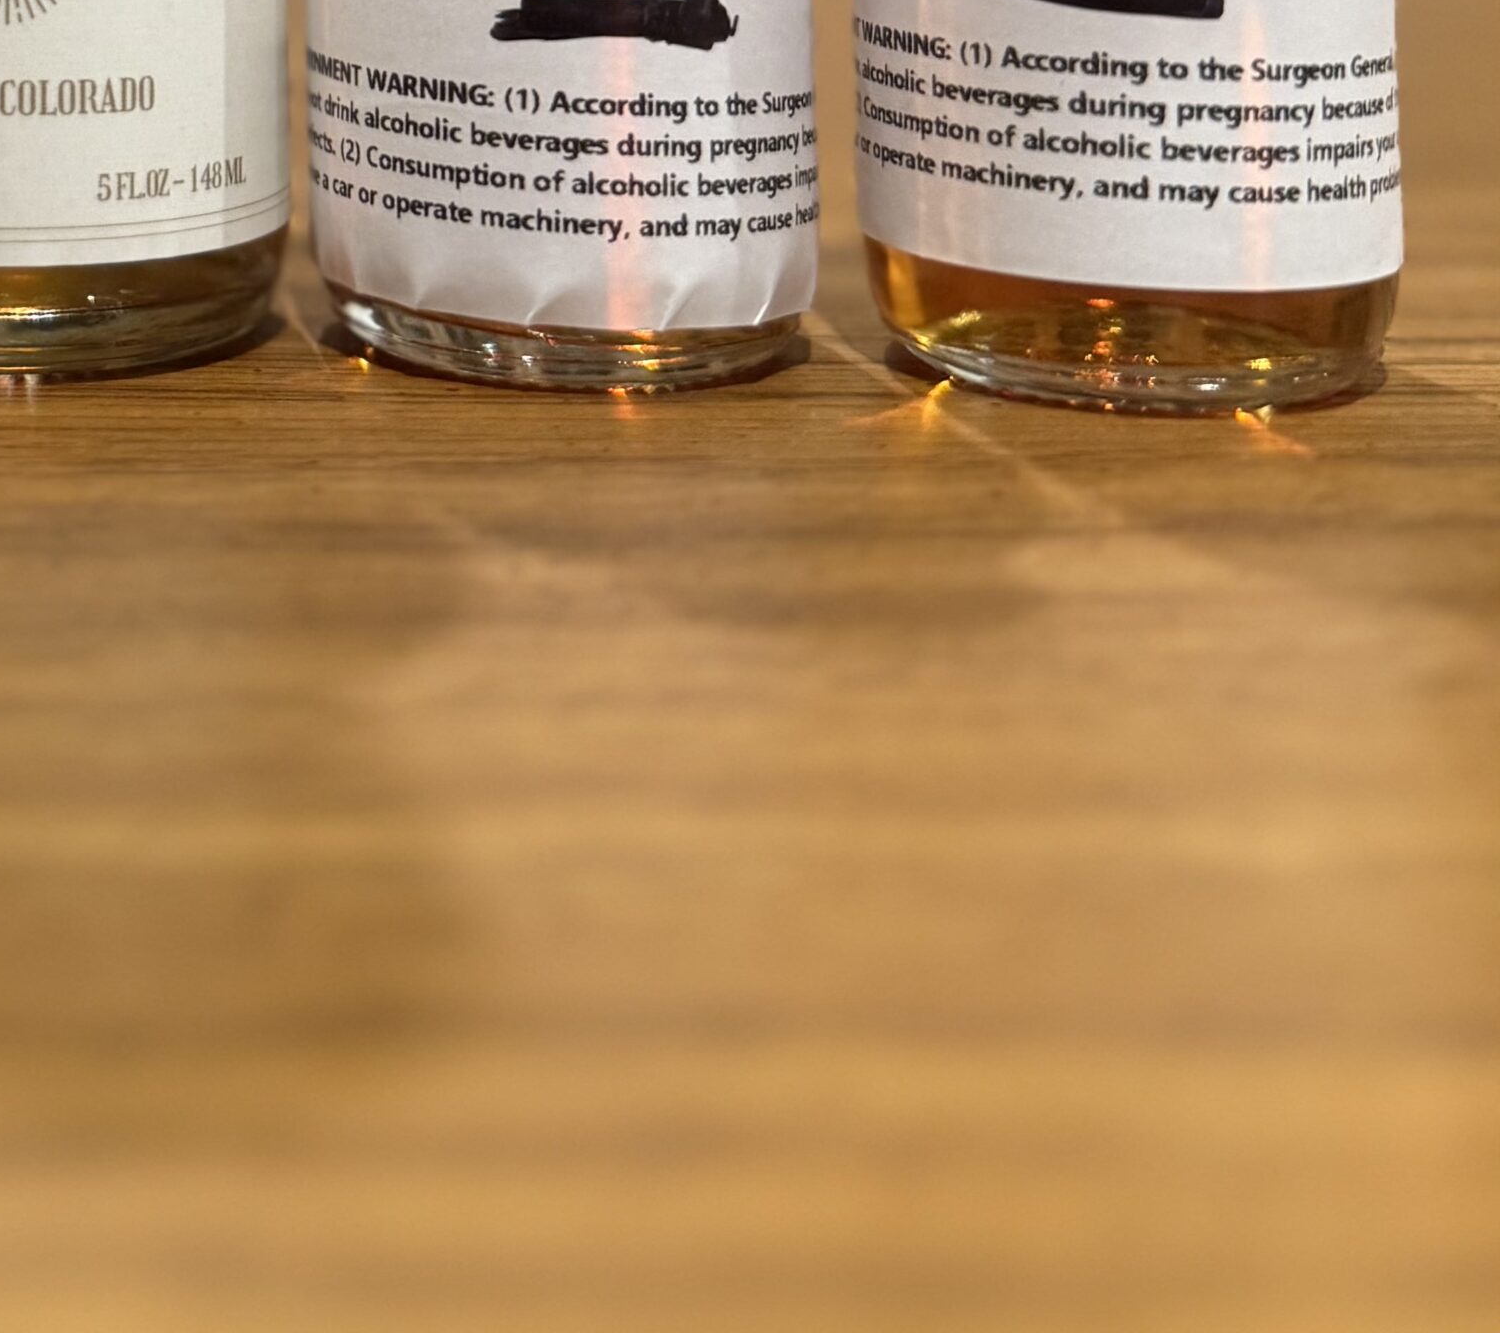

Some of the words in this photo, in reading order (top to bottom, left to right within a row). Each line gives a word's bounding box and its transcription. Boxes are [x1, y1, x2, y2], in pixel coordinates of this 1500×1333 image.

[861, 18, 951, 60] WARNING:
[960, 40, 992, 69] (1)
[1001, 46, 1149, 84] According
[1157, 57, 1188, 80] to
[1198, 56, 1244, 82] the
[1251, 57, 1346, 89] Surgeon
[324, 92, 360, 126] drink
[364, 106, 463, 144] alcoholic
[470, 121, 609, 161] beverages
[617, 132, 702, 164] during
[710, 130, 800, 163] pregnancy
[366, 66, 495, 108] WARNING:
[504, 86, 540, 115] (1)
[550, 90, 688, 124] According
[694, 95, 719, 117] to
[726, 91, 758, 117] the
[762, 90, 812, 119] Surgeon
[862, 59, 925, 95] alcoholic
[932, 73, 1059, 116] beverages
[1068, 90, 1165, 126] during
[1177, 101, 1315, 129] pregnancy
[1322, 95, 1384, 121] because
[340, 136, 361, 167] (2)
[366, 144, 526, 190] Consumption
[533, 169, 565, 193] of
[572, 170, 689, 198] alcoholic
[697, 171, 792, 199] beverages
[863, 96, 980, 141] Consumption
[987, 125, 1016, 147] of
[1023, 127, 1151, 159] alcoholic
[1161, 135, 1300, 169] beverages
[1306, 133, 1374, 167] impairs
[97, 173, 112, 201] 5
[115, 168, 171, 201] FL.OZ
[190, 161, 222, 192] 148
[225, 156, 247, 187] ML
[873, 141, 936, 175] operate
[941, 161, 1084, 201] machinery,
[1093, 176, 1149, 200] and
[1159, 182, 1219, 211] may
[1228, 182, 1300, 204] cause
[1307, 174, 1366, 203] health
[359, 185, 378, 206] or
[382, 192, 473, 224] operate
[481, 207, 630, 243] machinery,
[640, 212, 688, 238] and
[695, 216, 741, 241] may
[747, 211, 792, 234] cause
